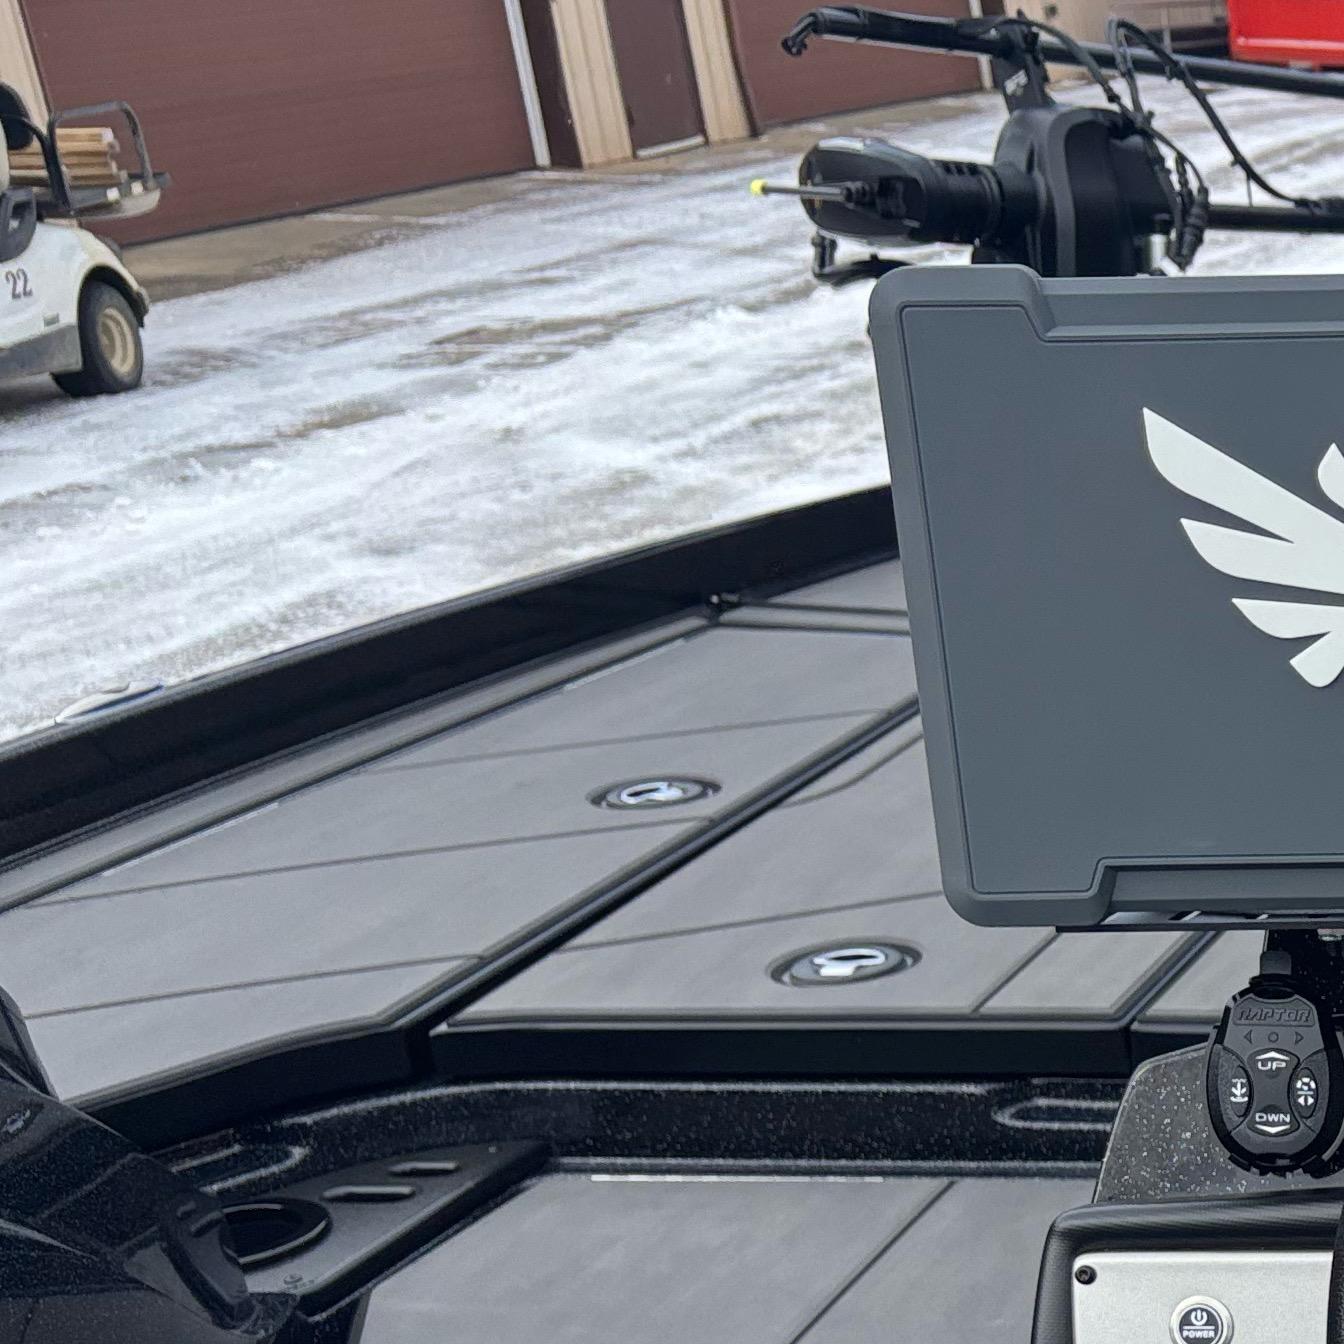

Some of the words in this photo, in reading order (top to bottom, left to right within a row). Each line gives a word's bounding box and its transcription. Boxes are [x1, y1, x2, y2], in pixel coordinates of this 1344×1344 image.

[5, 268, 33, 299] 22
[1240, 1007, 1311, 1021] RAPTOR
[1257, 1061, 1287, 1071] UP
[1255, 1112, 1291, 1123] DWN
[1182, 1330, 1215, 1338] POWER
